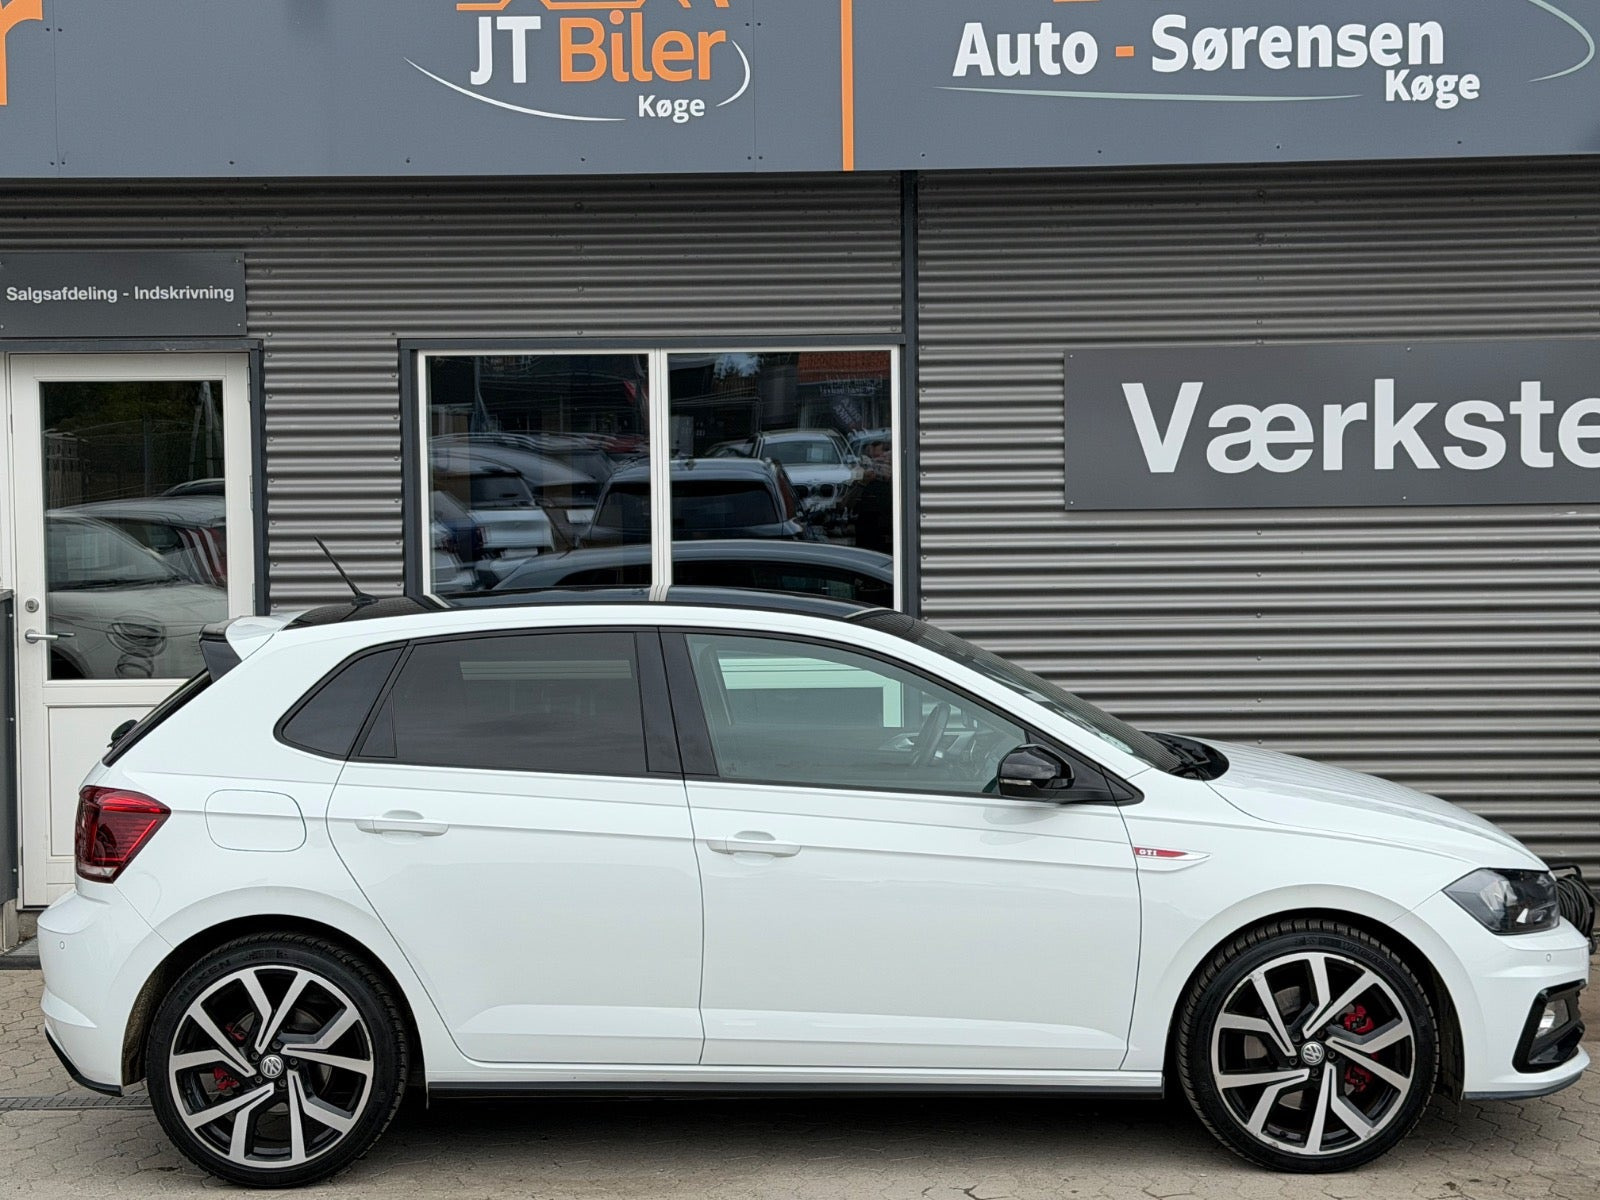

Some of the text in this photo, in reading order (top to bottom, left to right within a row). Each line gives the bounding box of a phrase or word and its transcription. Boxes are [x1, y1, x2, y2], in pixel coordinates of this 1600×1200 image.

[470, 9, 726, 85] JT Biler
[953, 22, 1098, 77] Auto
[1151, 14, 1444, 72] Sørensen
[638, 95, 705, 124] Køge
[1385, 68, 1481, 110] Køge
[6, 286, 118, 304] Salgsafdeling
[134, 285, 235, 303] Indskrivning
[1122, 378, 1600, 474] Værkste
[177, 959, 232, 1003] NEXEN
